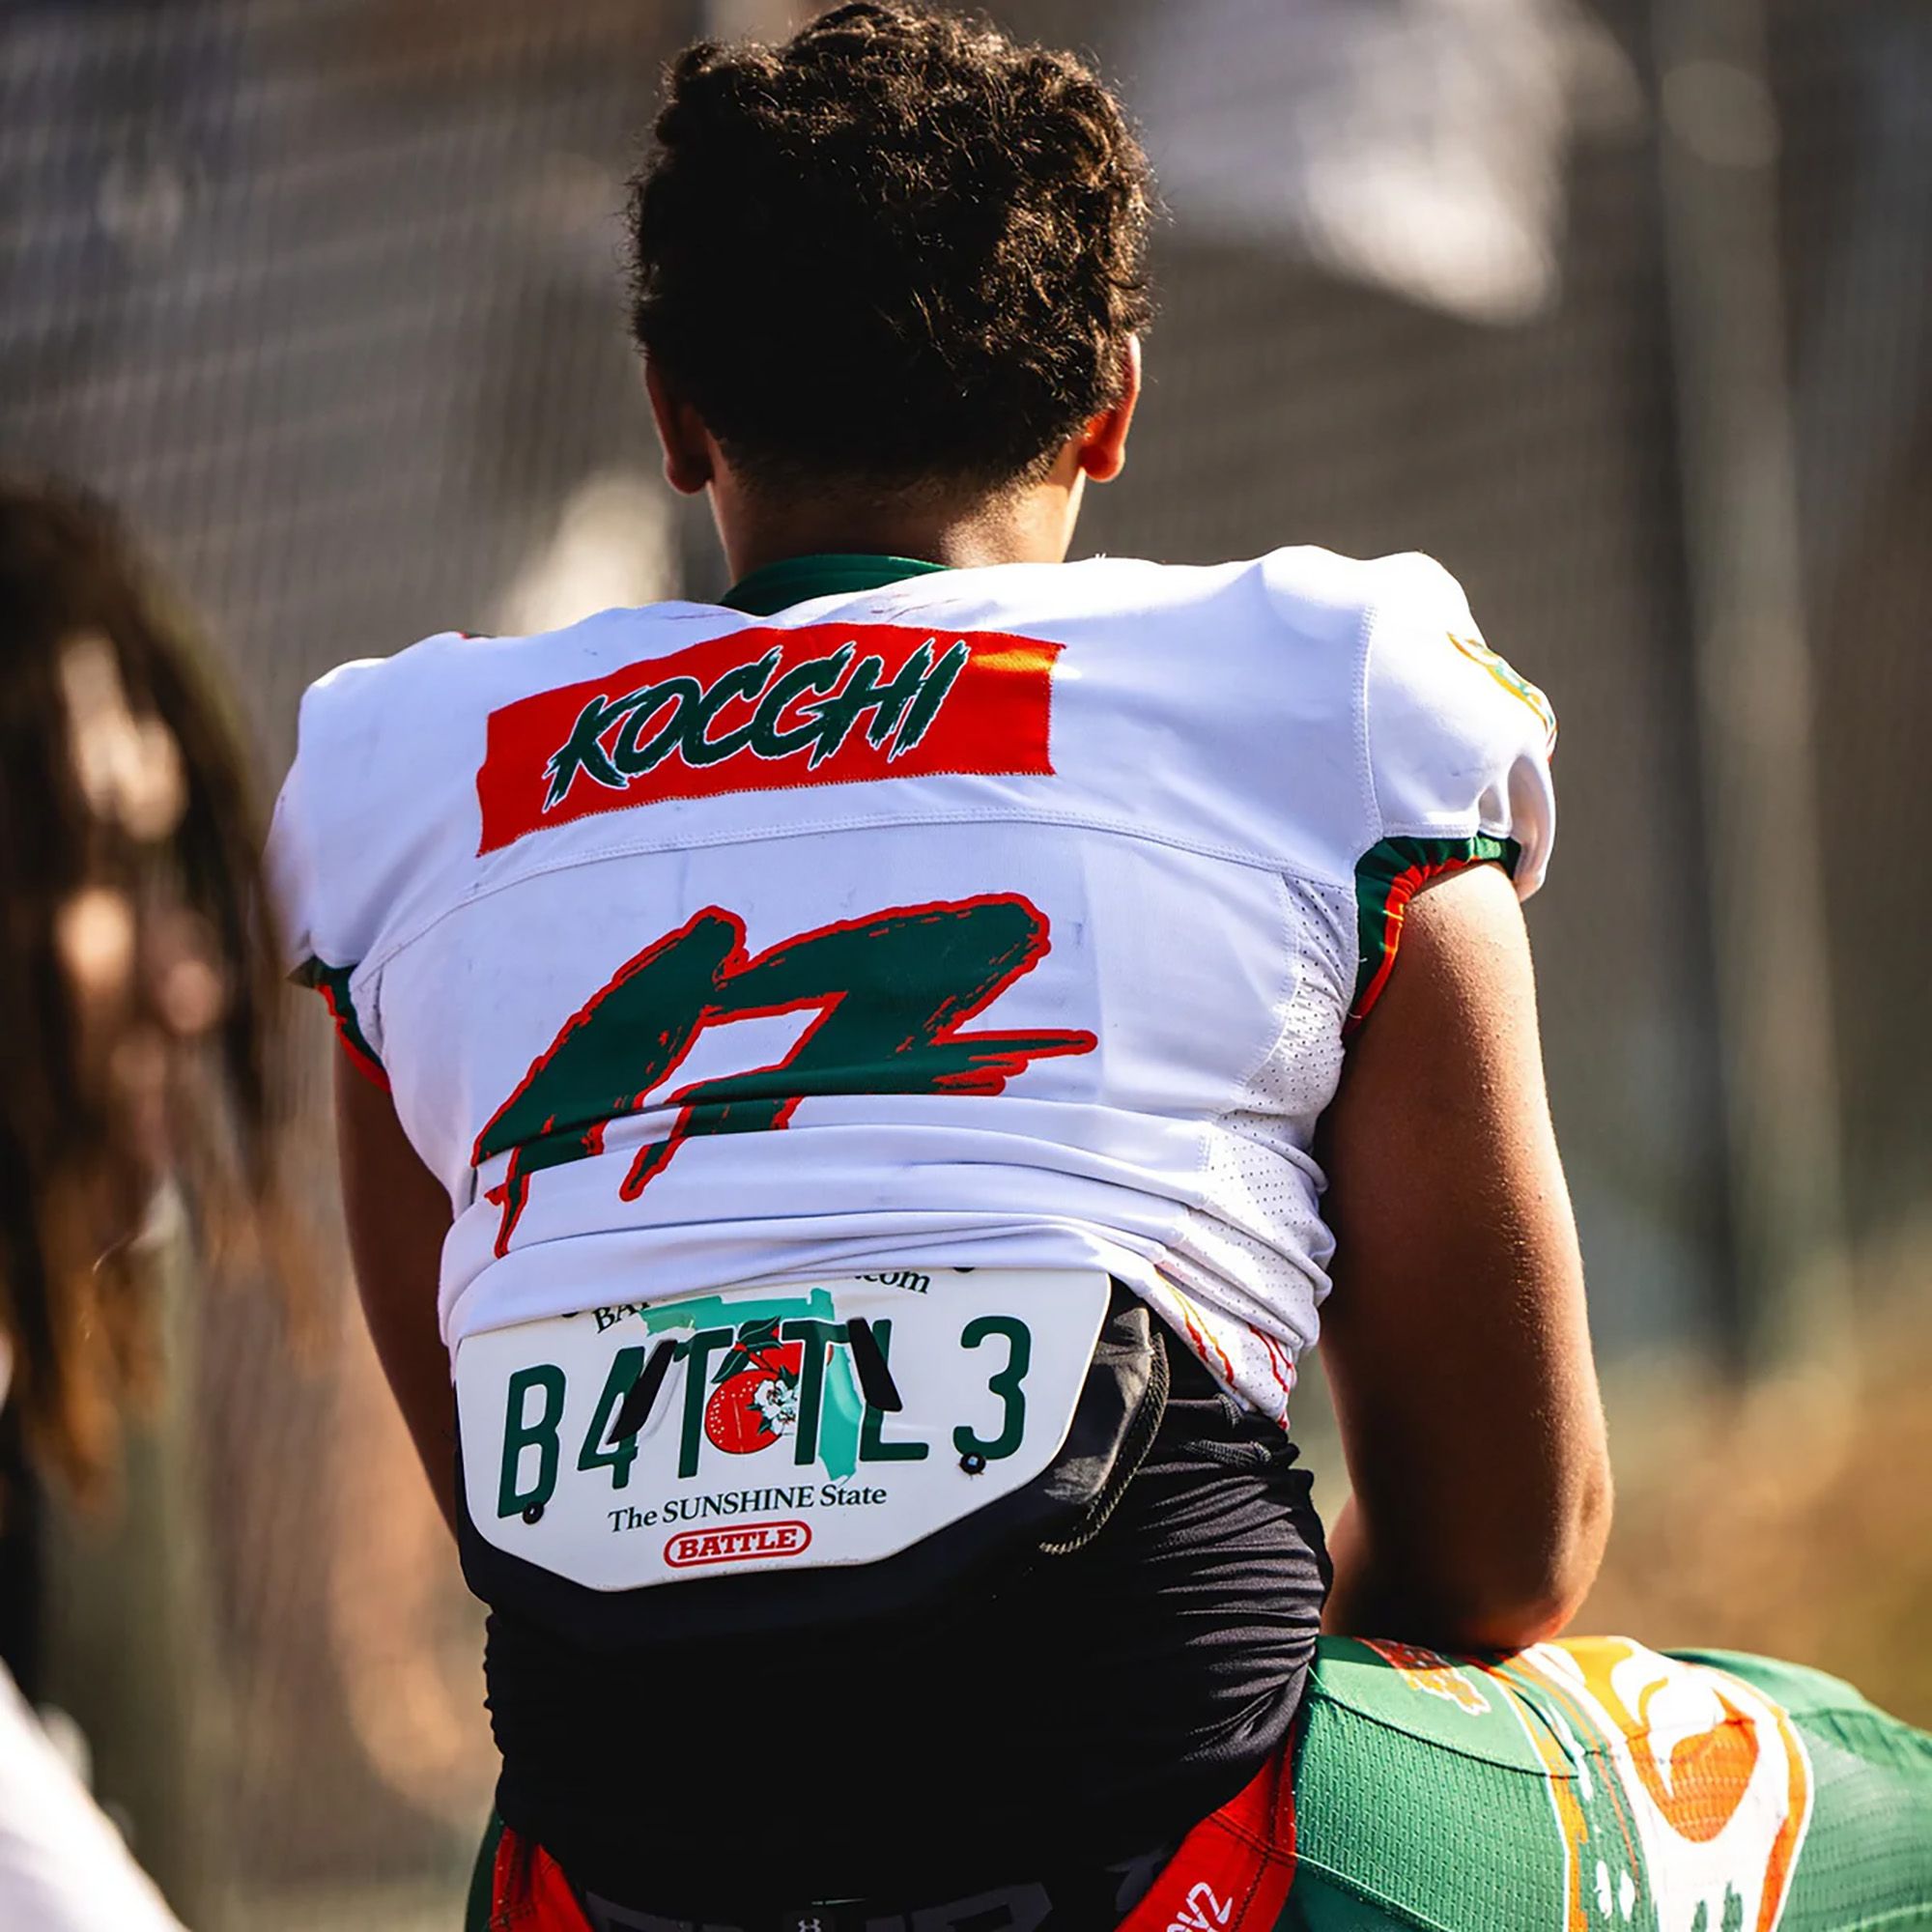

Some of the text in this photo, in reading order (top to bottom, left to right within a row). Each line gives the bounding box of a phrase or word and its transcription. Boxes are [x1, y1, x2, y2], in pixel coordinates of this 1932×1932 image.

[608, 1484, 887, 1533] The SUNSHINE State
[677, 1528, 798, 1560] BATTLE
